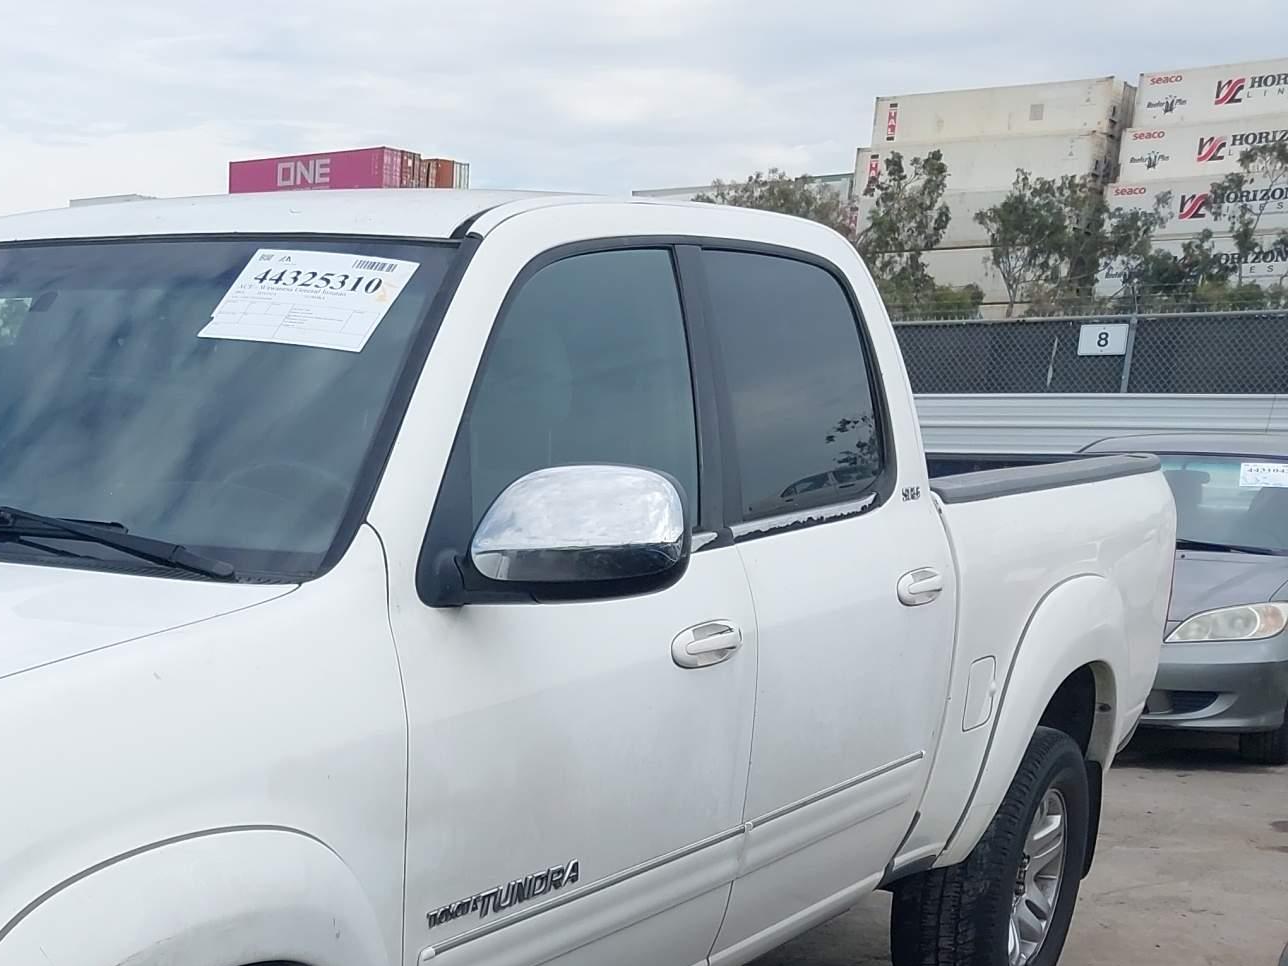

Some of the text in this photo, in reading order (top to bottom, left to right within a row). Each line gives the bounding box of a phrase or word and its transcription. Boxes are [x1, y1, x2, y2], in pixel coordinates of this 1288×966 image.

[1150, 74, 1183, 85] seaco
[1132, 130, 1165, 141] seaco
[277, 158, 330, 187] ONE
[1114, 186, 1146, 196] seaco
[254, 267, 383, 295] 44325310
[1096, 331, 1110, 348] 8
[478, 858, 579, 919] TUNDRA
